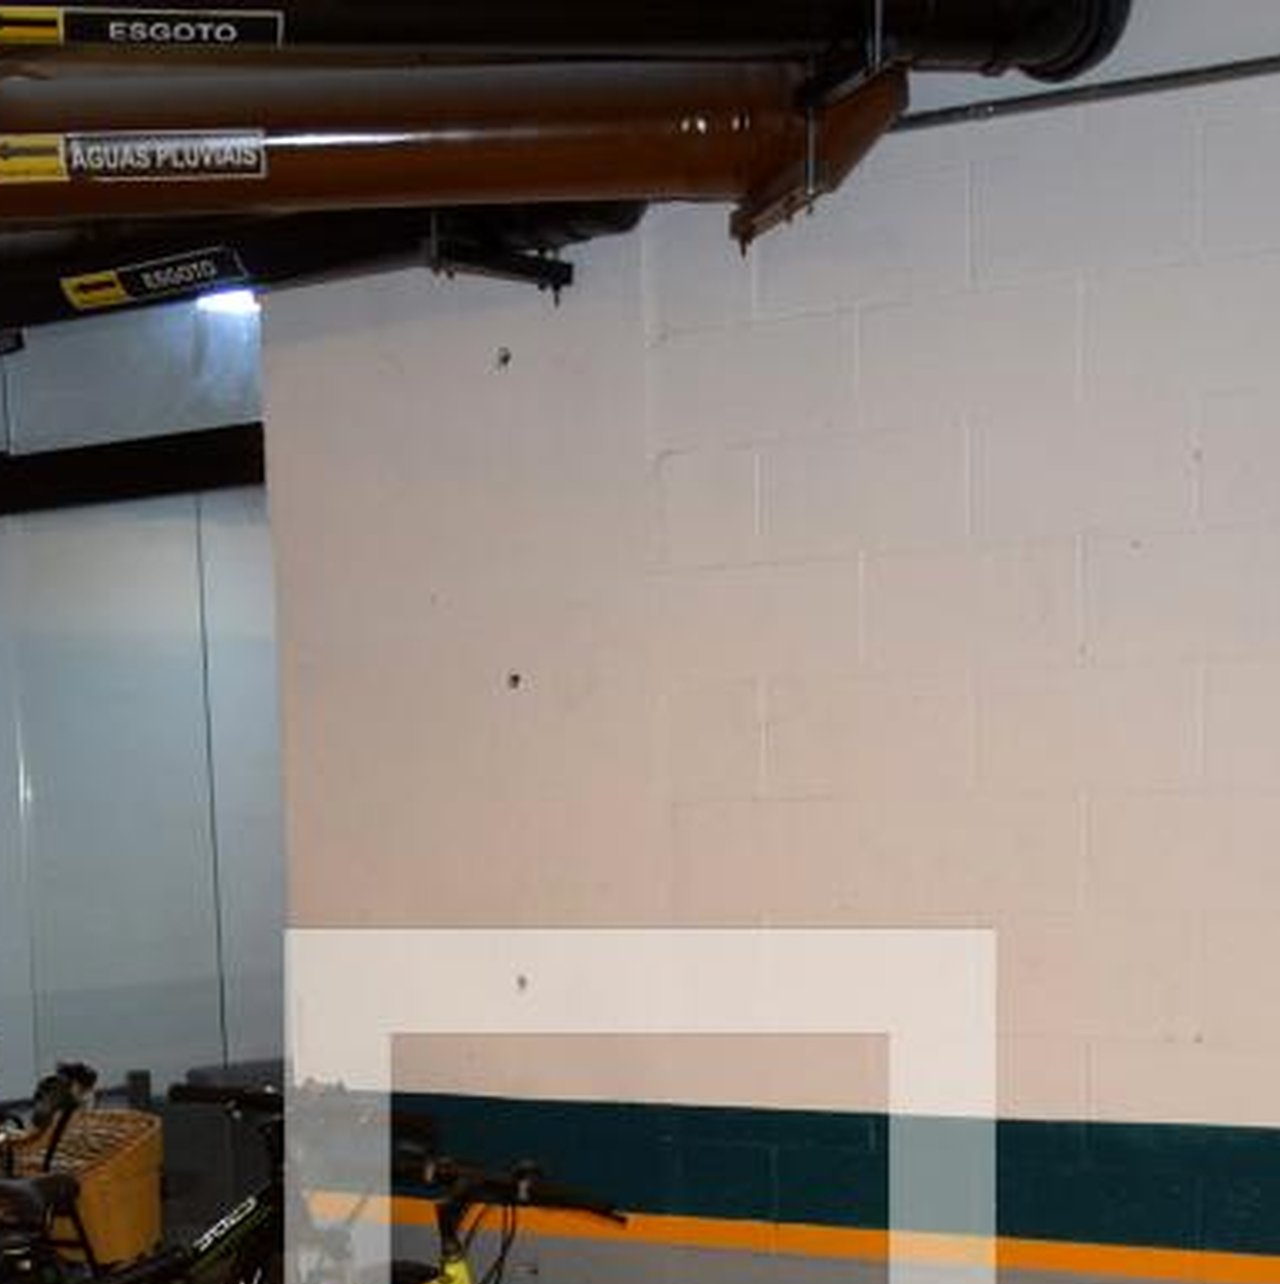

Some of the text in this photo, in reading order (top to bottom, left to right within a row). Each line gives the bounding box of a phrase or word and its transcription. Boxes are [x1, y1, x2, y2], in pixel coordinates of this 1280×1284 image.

[108, 21, 239, 43] ESGOTO
[155, 142, 259, 169] PLUVIAIS
[140, 259, 218, 290] ESGOTO
